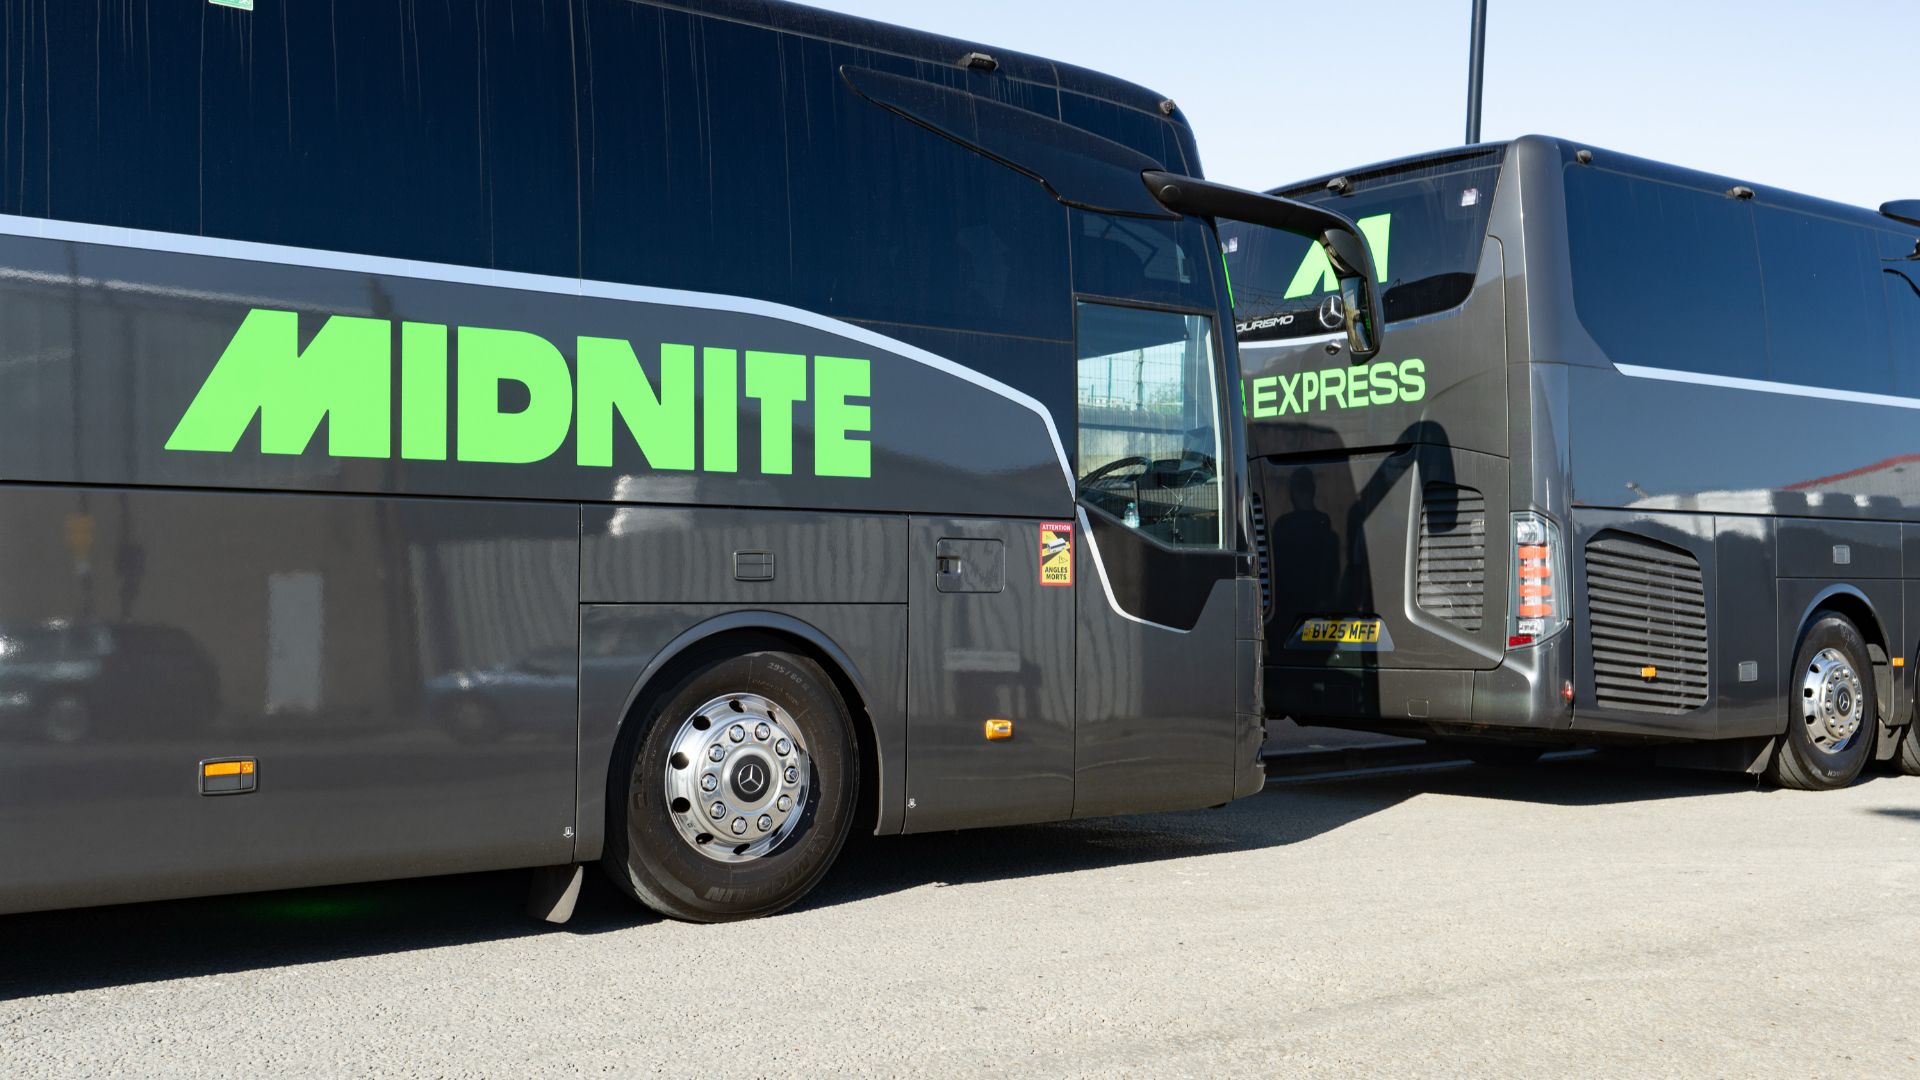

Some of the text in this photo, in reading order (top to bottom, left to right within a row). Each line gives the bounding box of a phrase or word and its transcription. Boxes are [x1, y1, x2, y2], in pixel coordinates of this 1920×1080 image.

[1236, 315, 1294, 333] OURISMO
[164, 308, 871, 478] MIDNITE
[1253, 358, 1426, 419] EXPRESS
[1312, 623, 1347, 639] BV25
[1349, 623, 1377, 640] MFF
